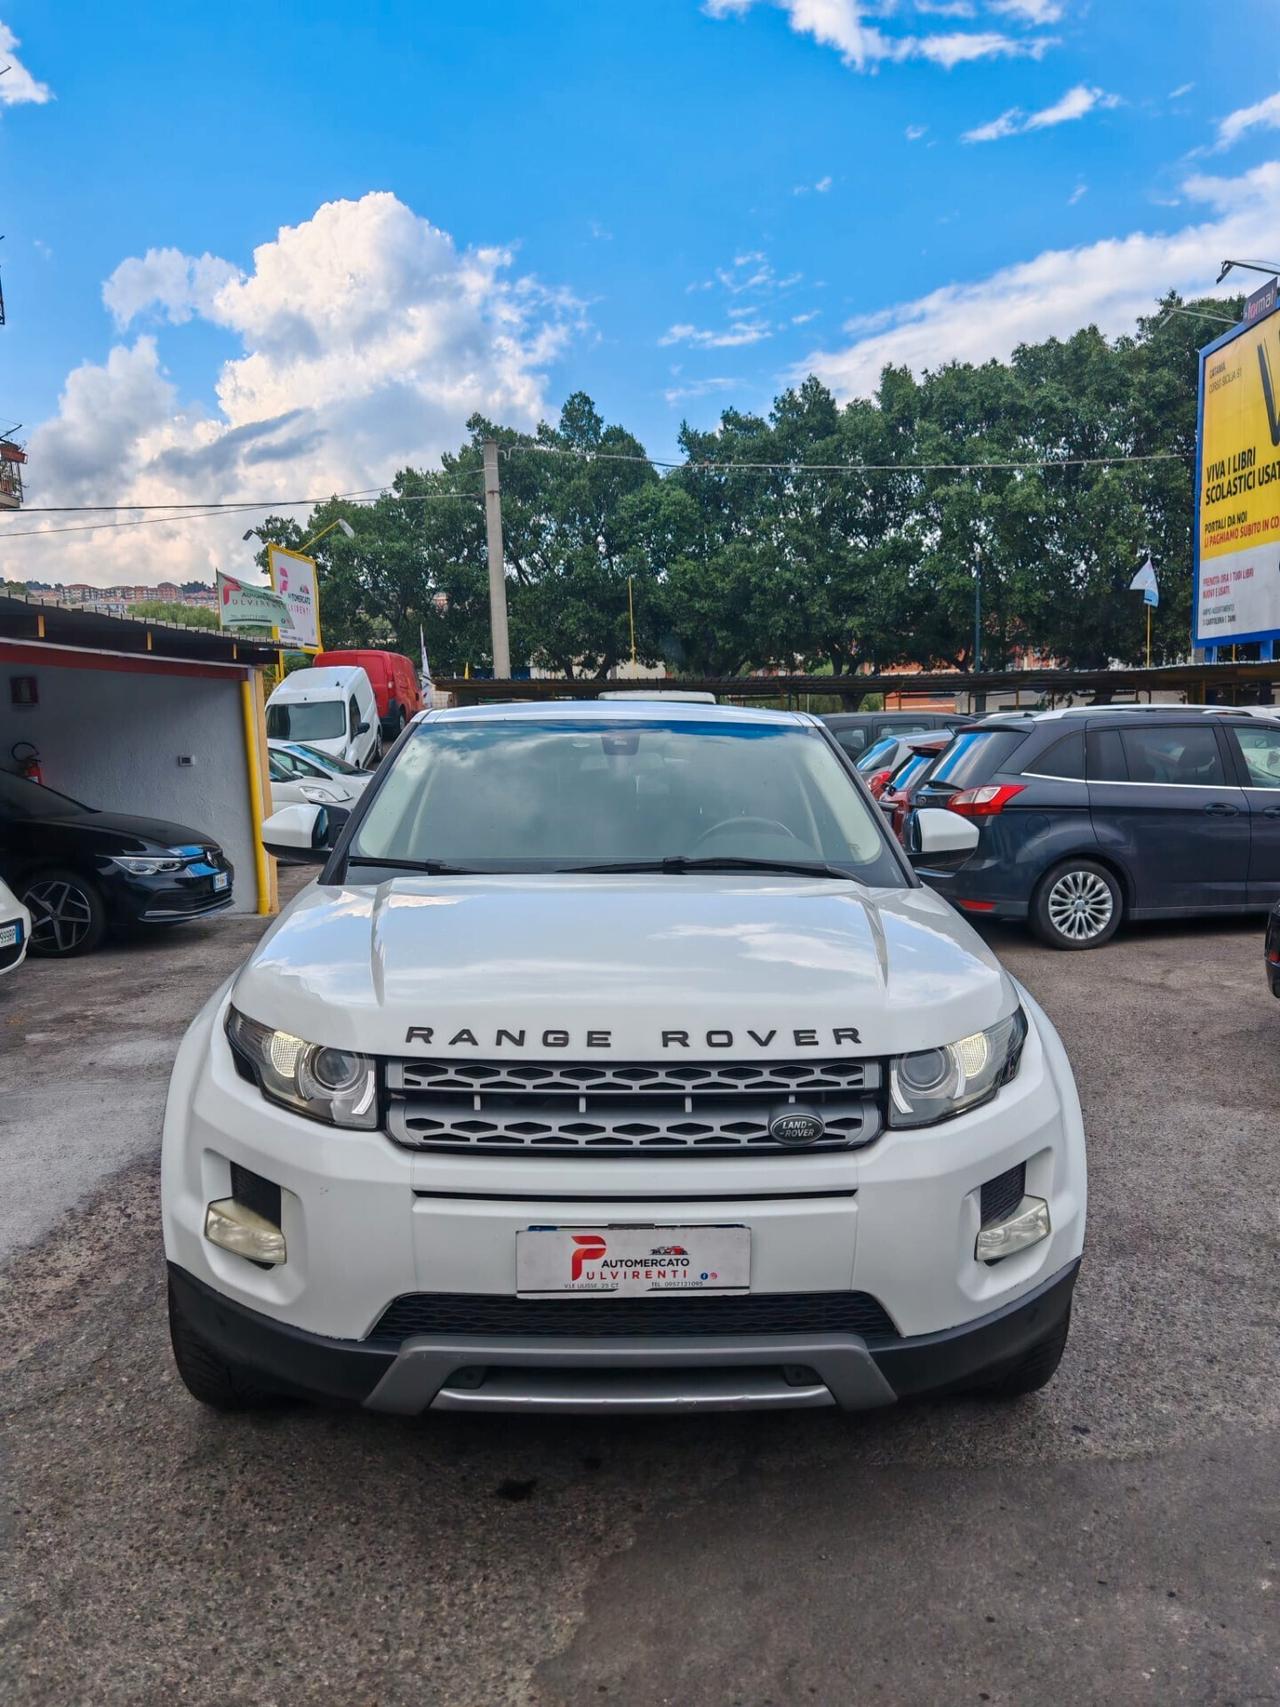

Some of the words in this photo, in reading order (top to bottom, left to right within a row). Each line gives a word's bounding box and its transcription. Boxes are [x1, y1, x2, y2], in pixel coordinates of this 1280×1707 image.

[1206, 460, 1226, 483] VIVA
[1228, 457, 1231, 475] I
[1233, 446, 1256, 473] LIBRI
[1206, 470, 1256, 506] SCOLASTICI
[1204, 517, 1227, 533] PORTALI
[1227, 515, 1236, 528] DA
[1237, 511, 1248, 525] NOI
[1210, 527, 1239, 546] PAGHIAMO
[1240, 521, 1261, 538] SUBITO
[1262, 519, 1269, 531] IN
[404, 1026, 613, 1049] RANGE
[661, 1027, 864, 1048] ROVER
[601, 1258, 690, 1268] AUTOMERCATO
